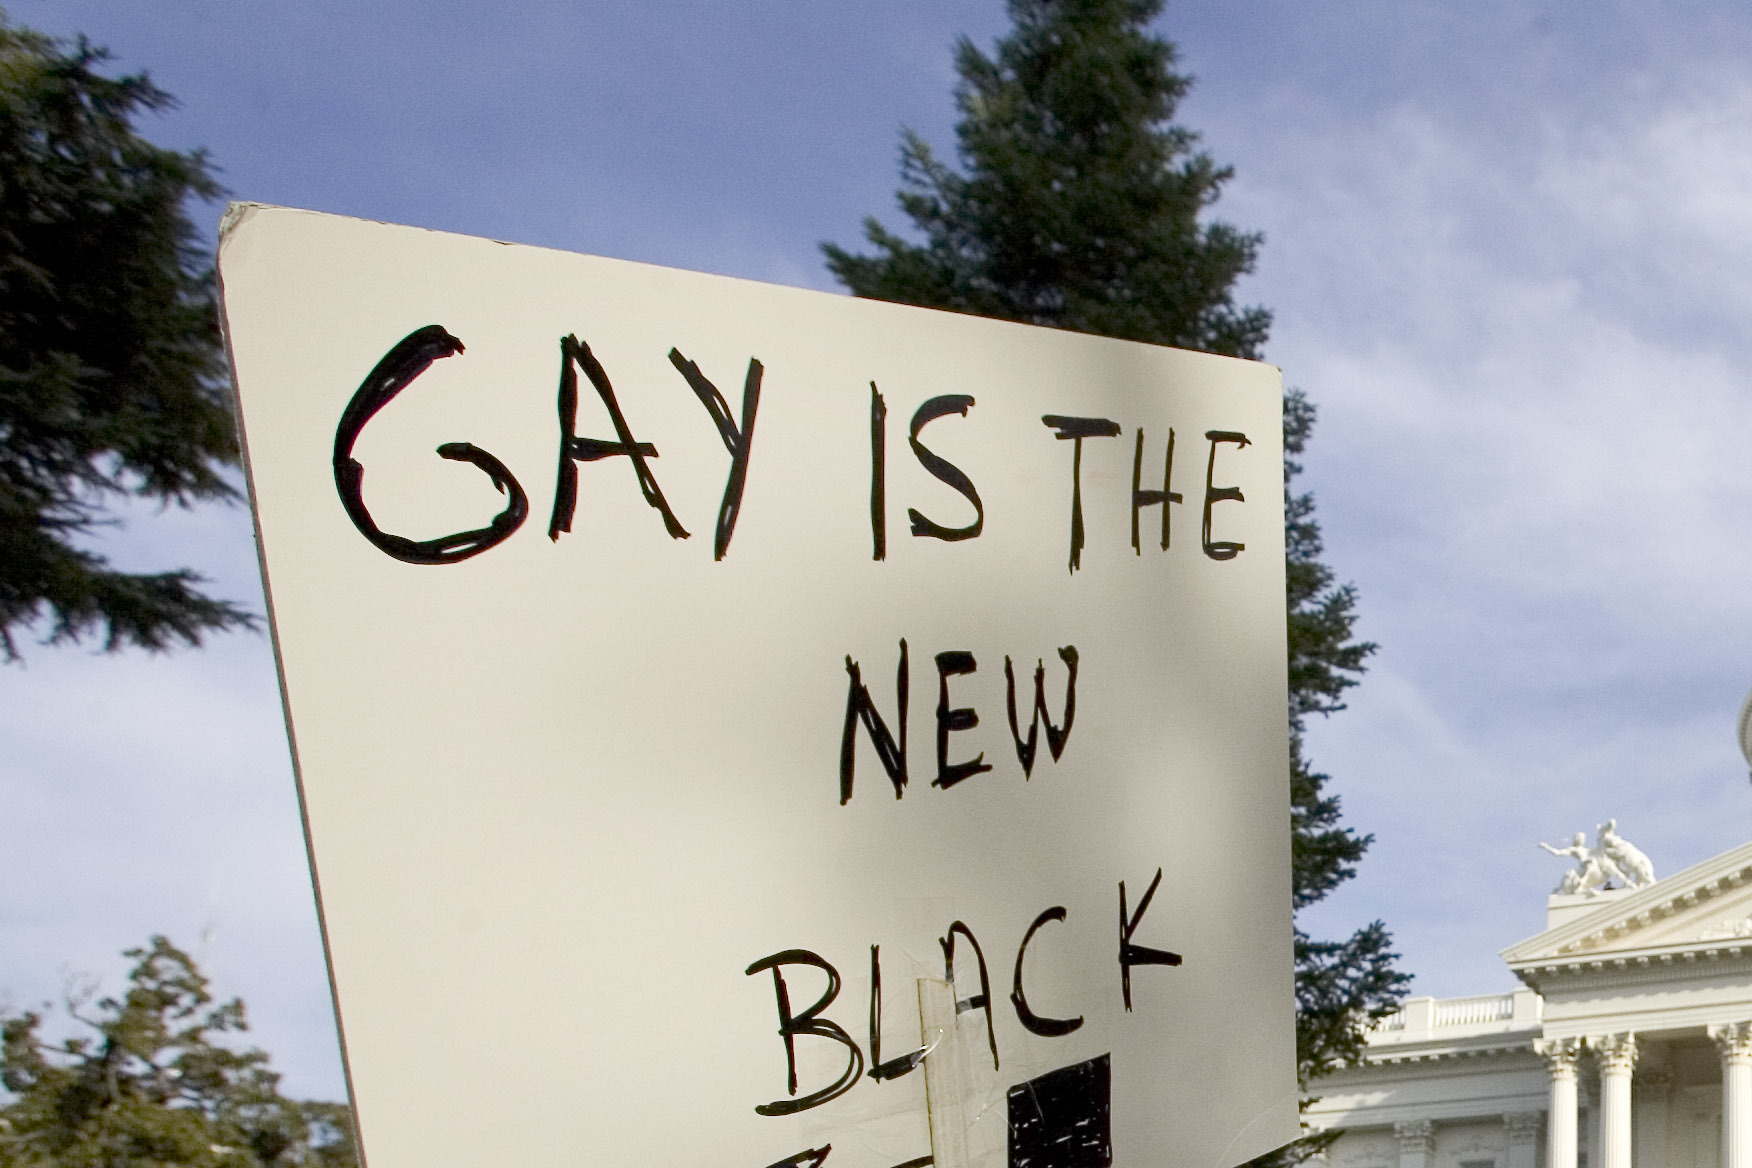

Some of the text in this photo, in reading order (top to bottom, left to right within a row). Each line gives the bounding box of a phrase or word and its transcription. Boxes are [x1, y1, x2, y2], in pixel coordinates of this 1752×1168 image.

[333, 325, 1251, 575] GAY IS THE
[840, 638, 1079, 806] NEW
[745, 867, 1182, 1116] BLACK
